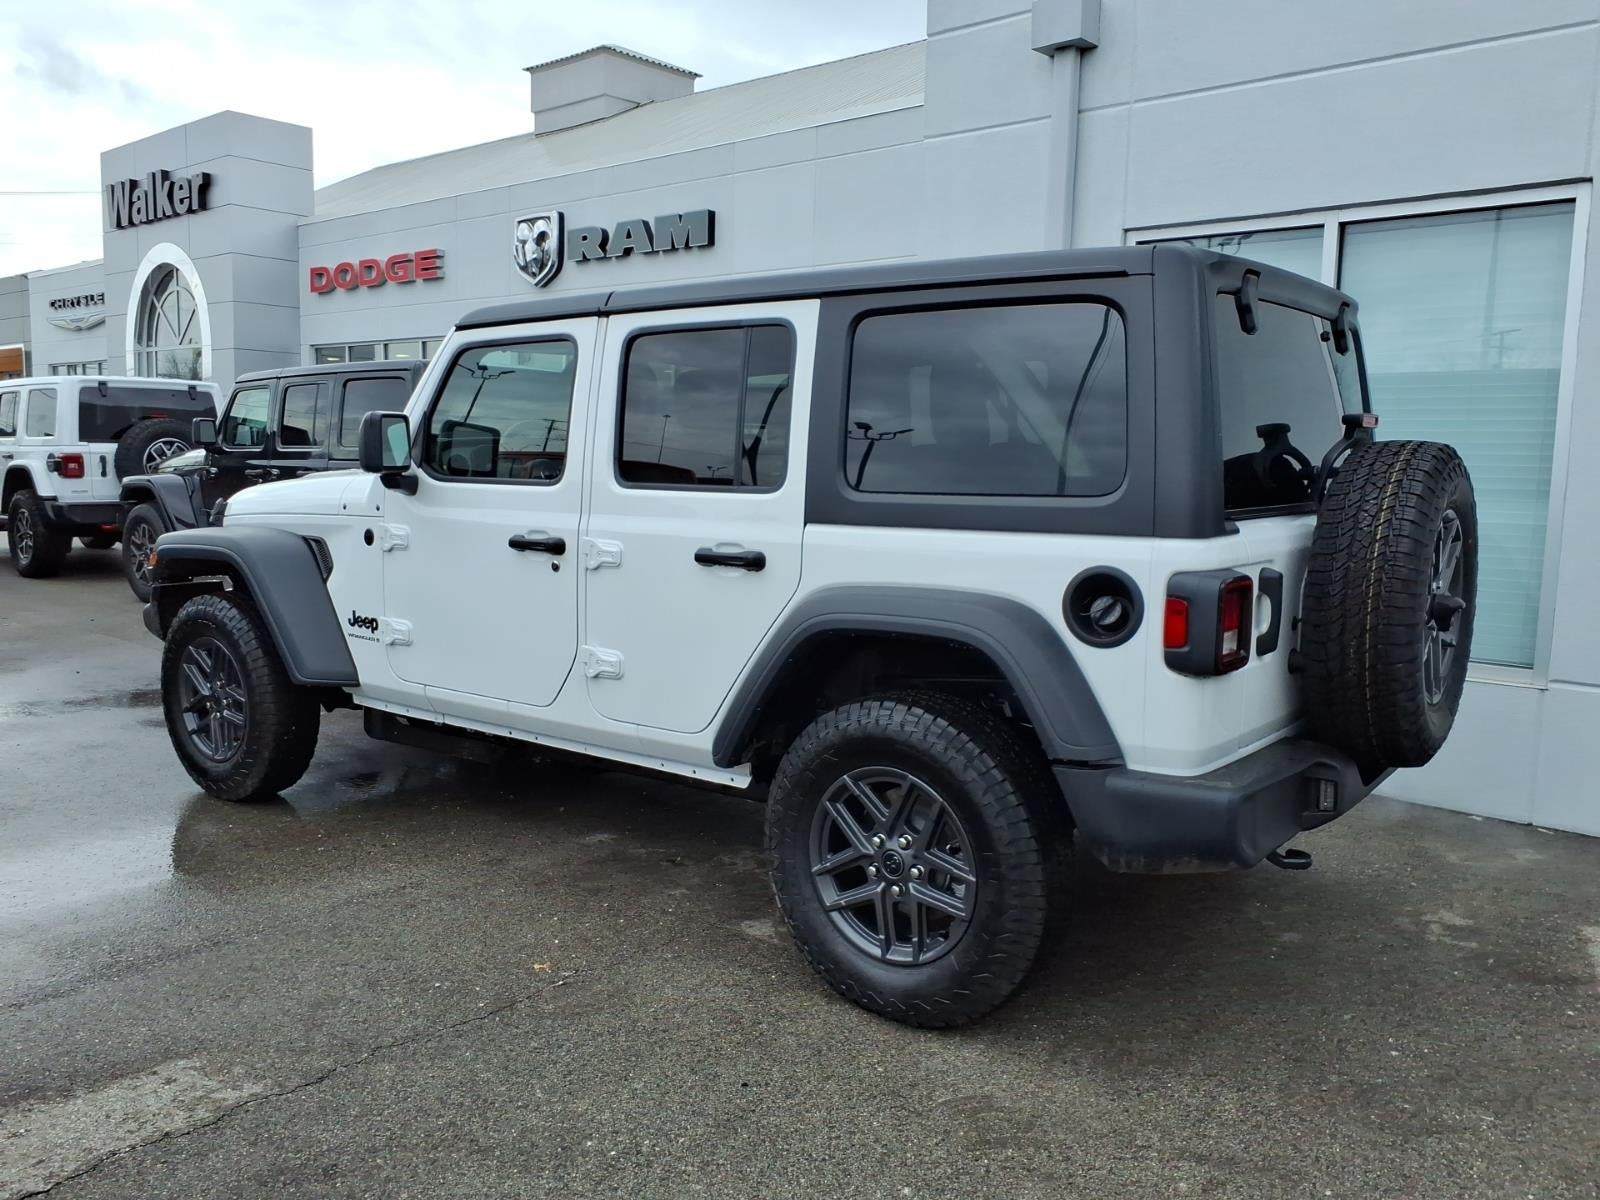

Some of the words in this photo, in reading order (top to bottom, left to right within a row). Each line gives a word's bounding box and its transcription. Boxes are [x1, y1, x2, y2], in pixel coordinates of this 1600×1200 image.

[105, 169, 211, 229] Walker
[567, 209, 715, 263] RAM
[309, 248, 445, 294] DODGE
[348, 610, 378, 633] Jeep
